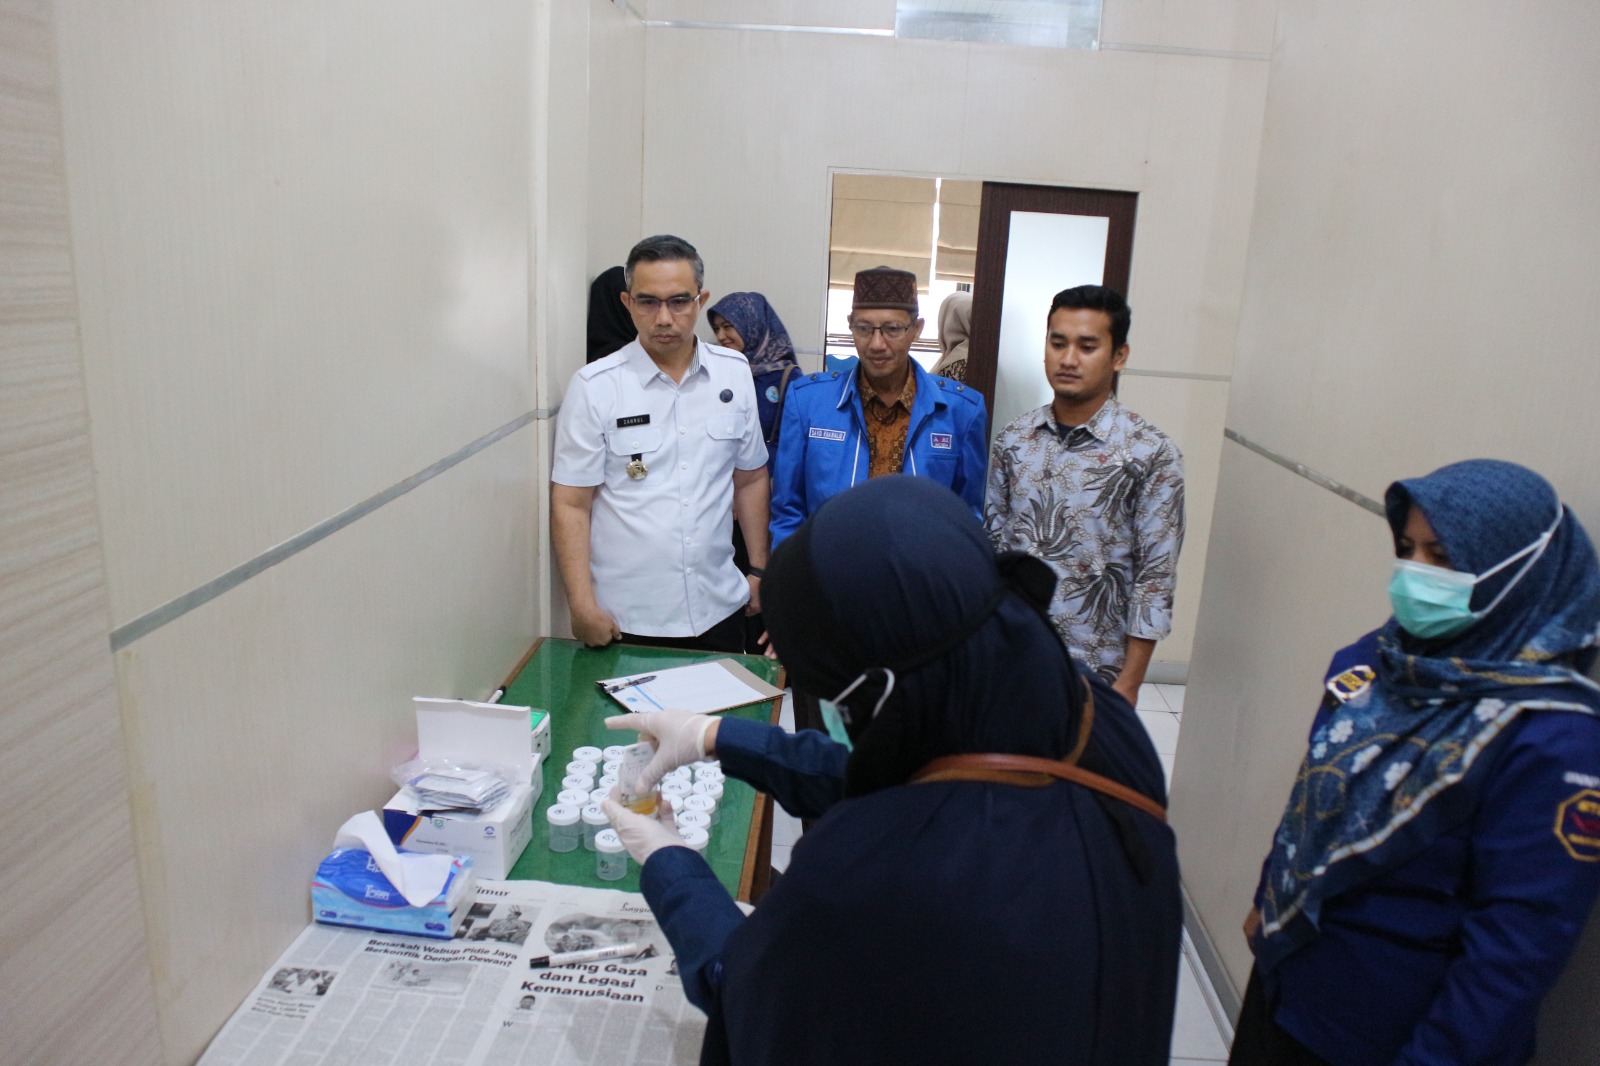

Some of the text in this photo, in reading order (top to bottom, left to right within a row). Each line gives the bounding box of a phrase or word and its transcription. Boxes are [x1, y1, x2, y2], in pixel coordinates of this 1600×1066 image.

[475, 885, 511, 897] imur
[364, 946, 513, 967] Berkonflik Dengan Dewan?
[368, 939, 518, 960] Benarkah Wabup Pidie Jaya
[604, 963, 648, 977] Gaza
[540, 971, 636, 989] dan Legasi
[520, 981, 644, 1003] Kemanusiaan
